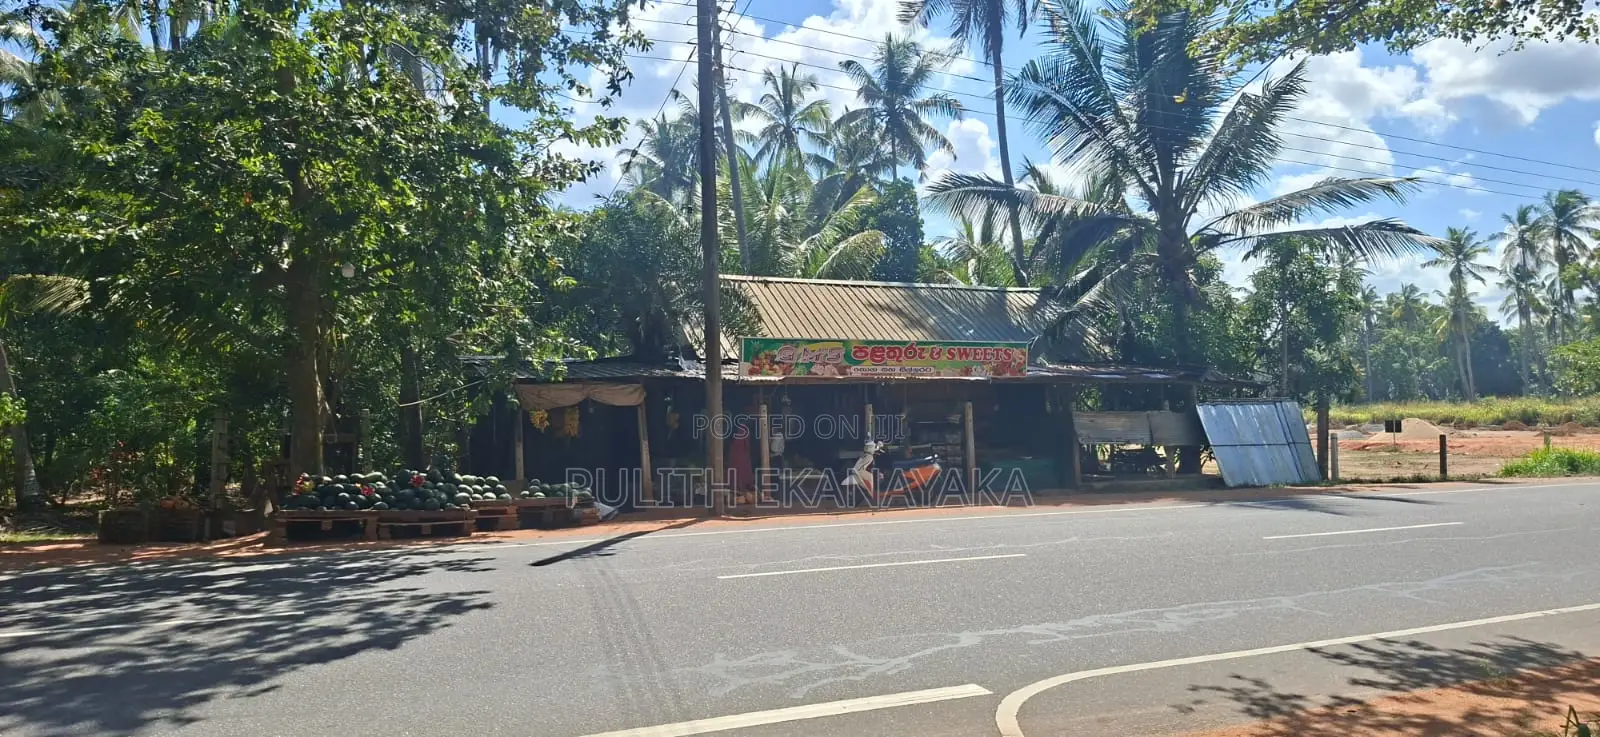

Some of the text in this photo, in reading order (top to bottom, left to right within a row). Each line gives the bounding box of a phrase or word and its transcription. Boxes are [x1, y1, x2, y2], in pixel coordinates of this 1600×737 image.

[852, 342, 926, 364] පළතුරු
[929, 345, 942, 360] &
[947, 347, 1012, 361] SWEETS
